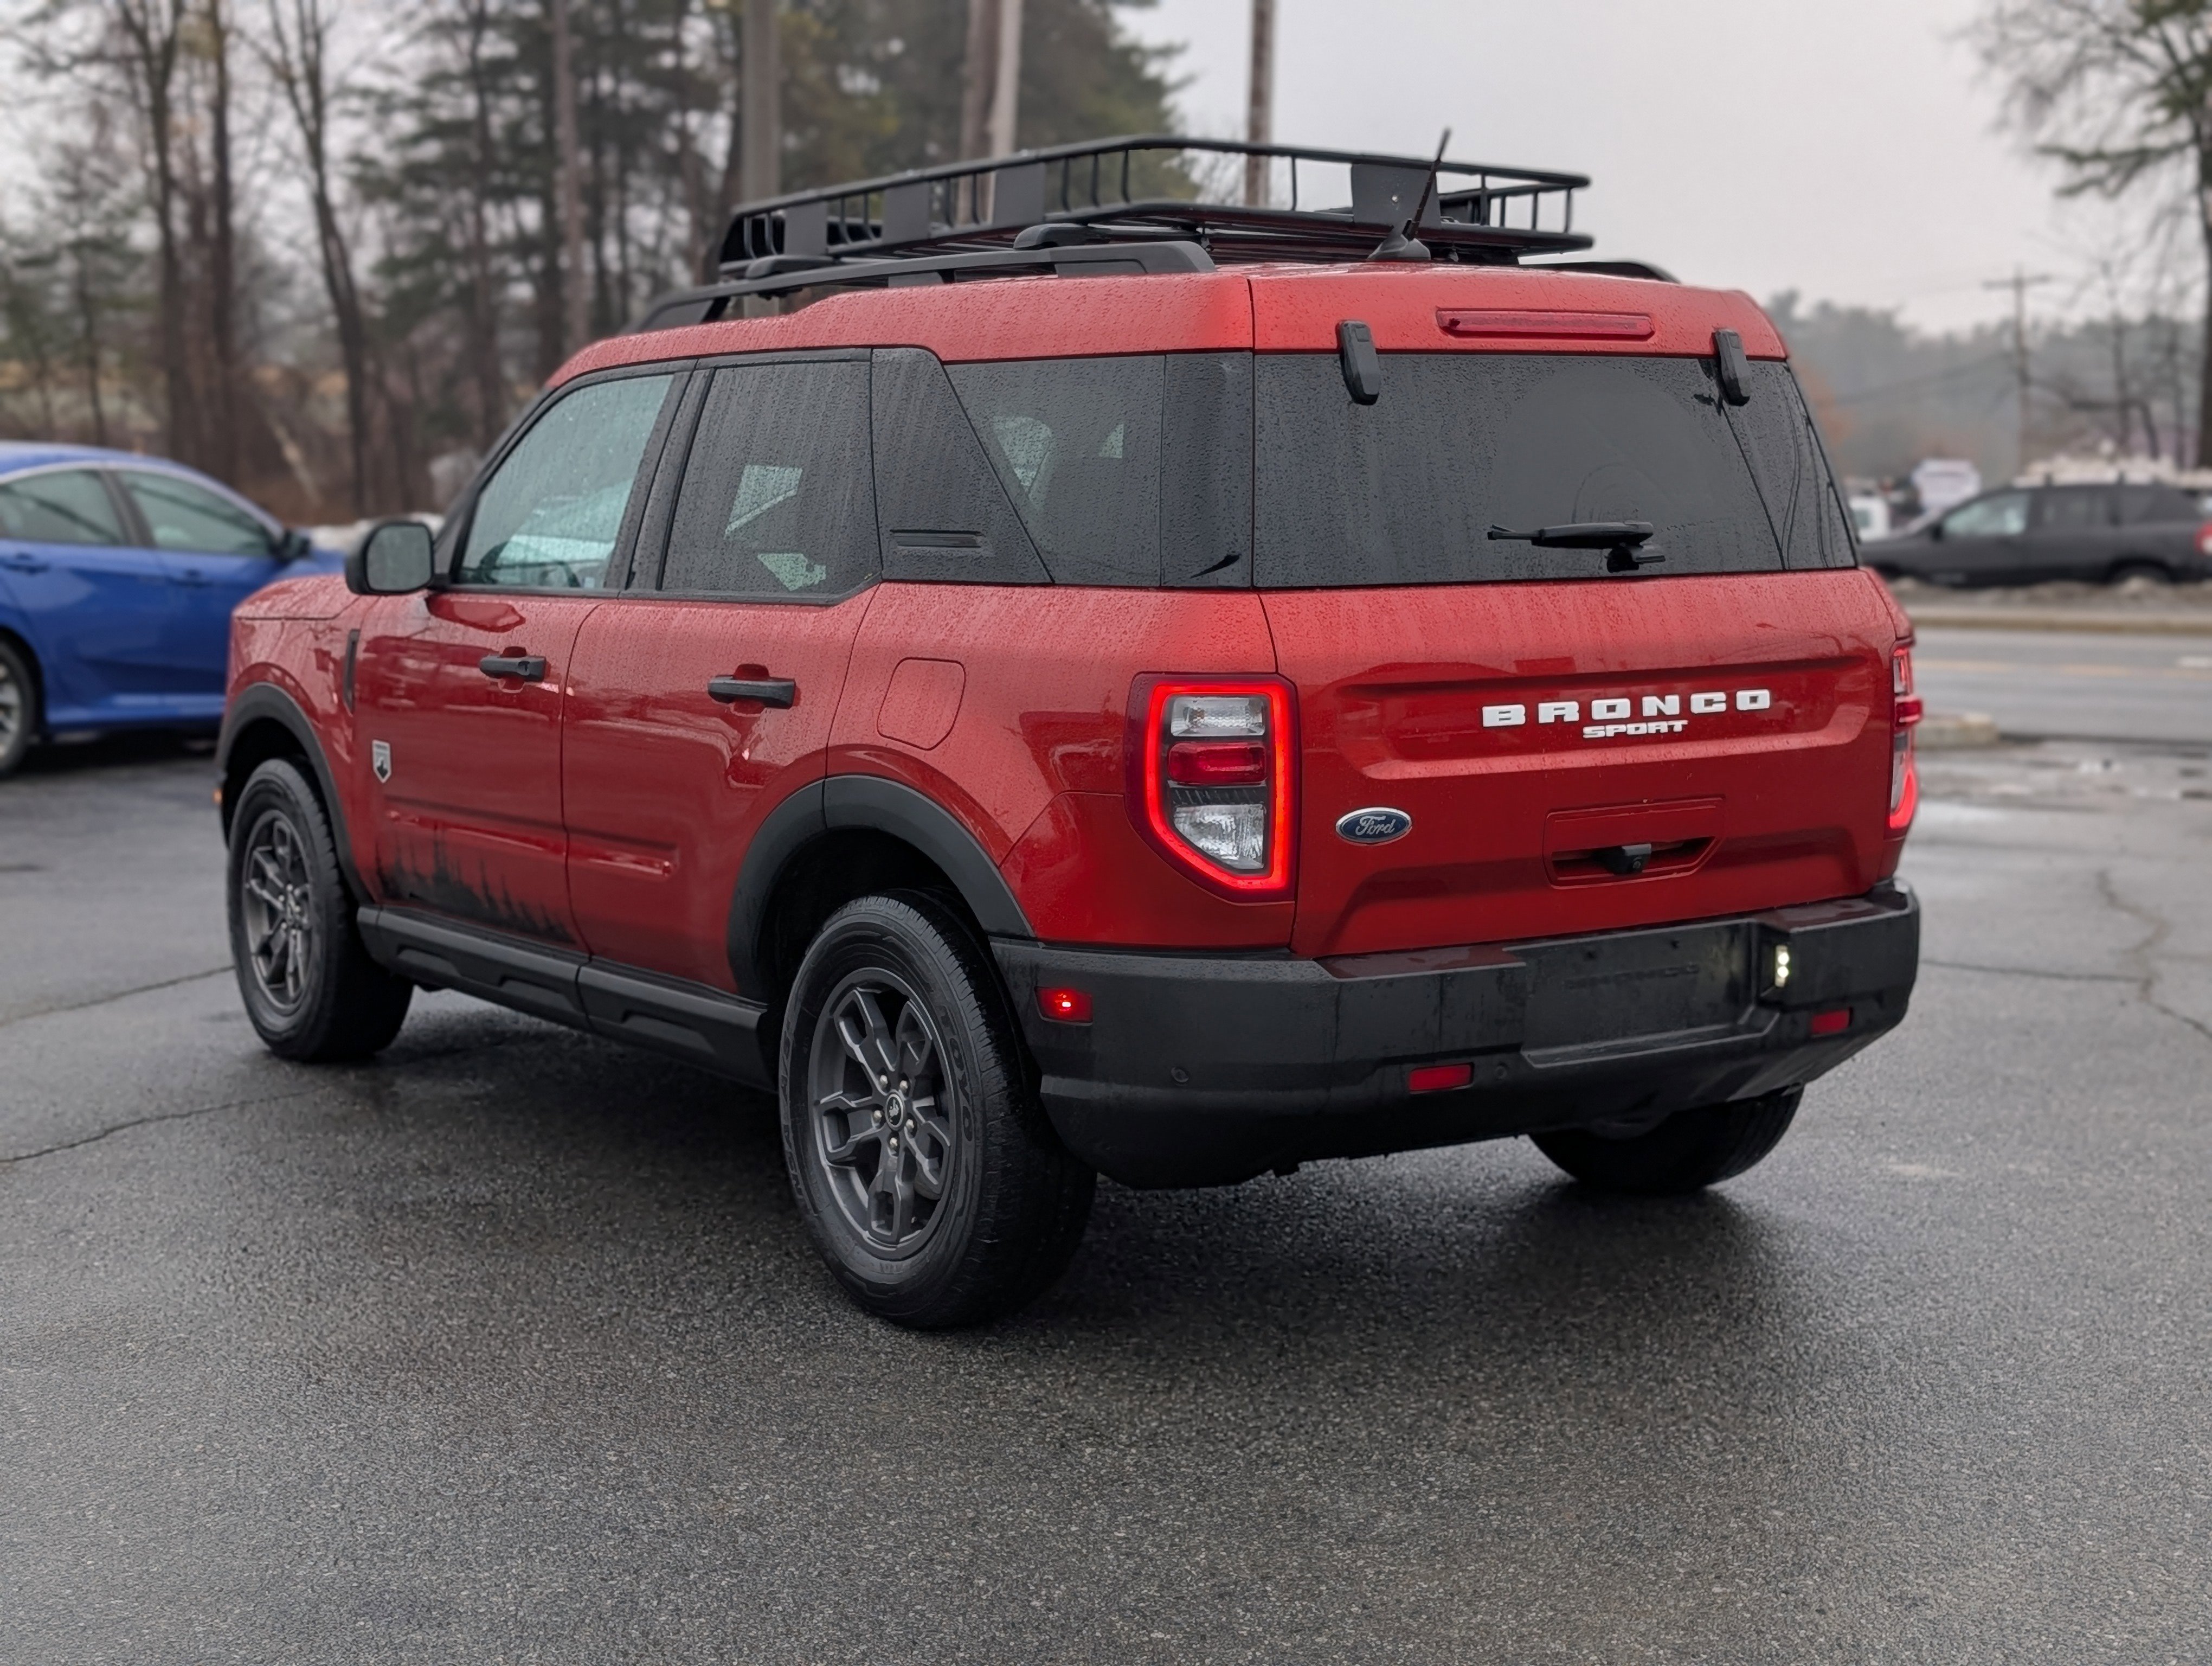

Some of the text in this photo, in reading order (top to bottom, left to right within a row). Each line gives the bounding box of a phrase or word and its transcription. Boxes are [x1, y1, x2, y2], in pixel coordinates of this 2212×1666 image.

[1482, 689, 1770, 727] BRONCO
[1583, 720, 1688, 738] SPORT
[1355, 815, 1396, 836] Ford
[941, 1005, 973, 1141] TOYO
